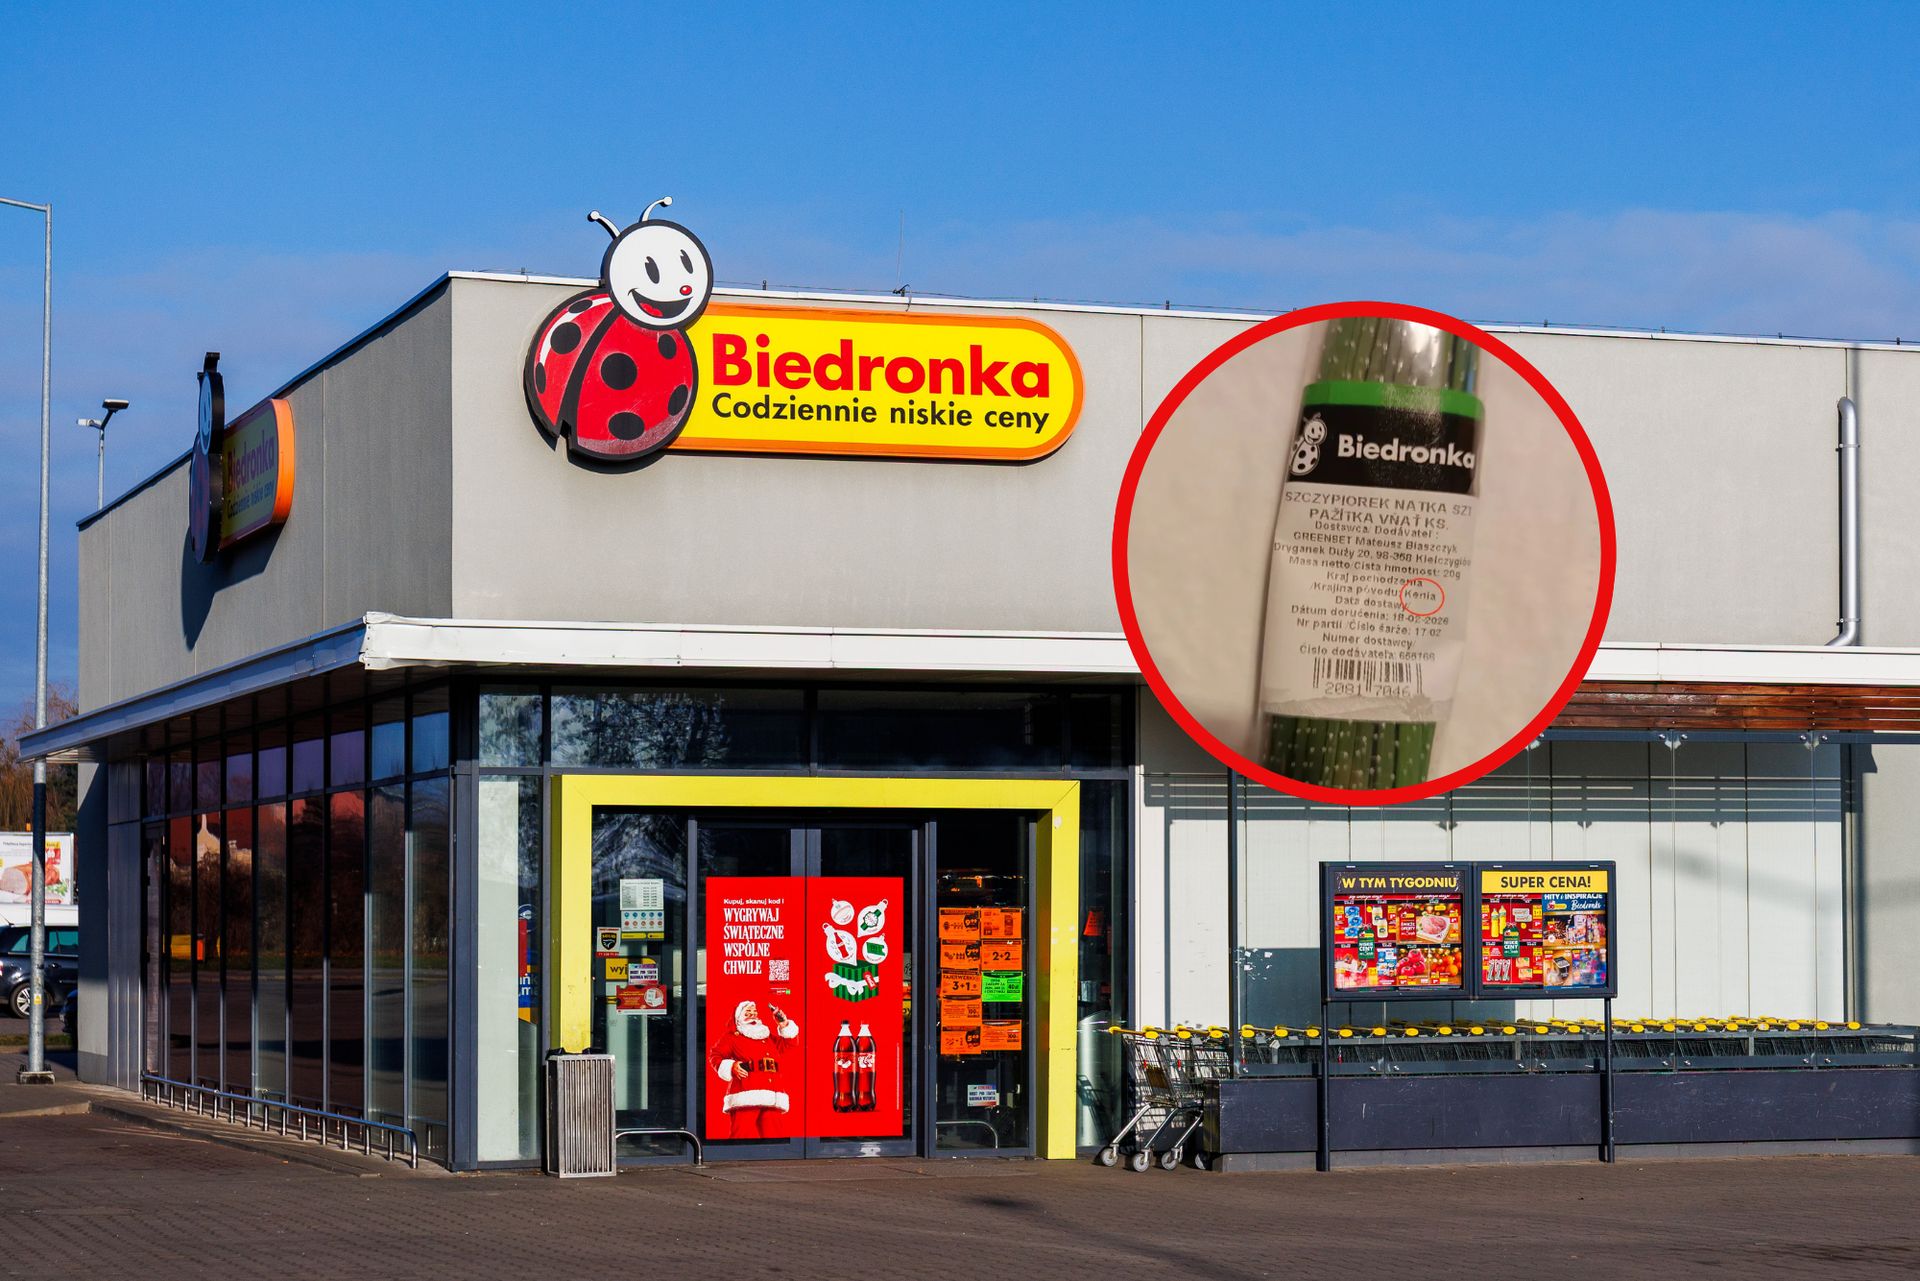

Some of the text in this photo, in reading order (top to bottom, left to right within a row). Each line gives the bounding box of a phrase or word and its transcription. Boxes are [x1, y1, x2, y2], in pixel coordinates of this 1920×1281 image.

[712, 333, 1050, 399] Biedronka
[712, 392, 1050, 435] Codziennie niskie ceny
[1337, 433, 1476, 470] Biedronka
[1285, 491, 1390, 509] SZCZYPIOREK
[1394, 499, 1447, 513] NATKA
[1355, 536, 1402, 549] Mateusz
[1289, 556, 1318, 567] Masa
[1327, 571, 1349, 583] Kraj
[1335, 595, 1360, 605] Data
[1404, 590, 1436, 601] Kenia
[1296, 618, 1309, 627] Nr
[1313, 619, 1342, 630] partii
[1322, 632, 1360, 643] Numer
[1341, 876, 1458, 889] W TYM TYGODNIU
[1500, 876, 1591, 888] SUPER CENA!
[723, 907, 780, 922] WYGRYWAJ
[723, 922, 785, 942] ŚWIĄTECZNE
[723, 940, 771, 957] WSPÓLNE
[723, 960, 763, 975] CHWILE
